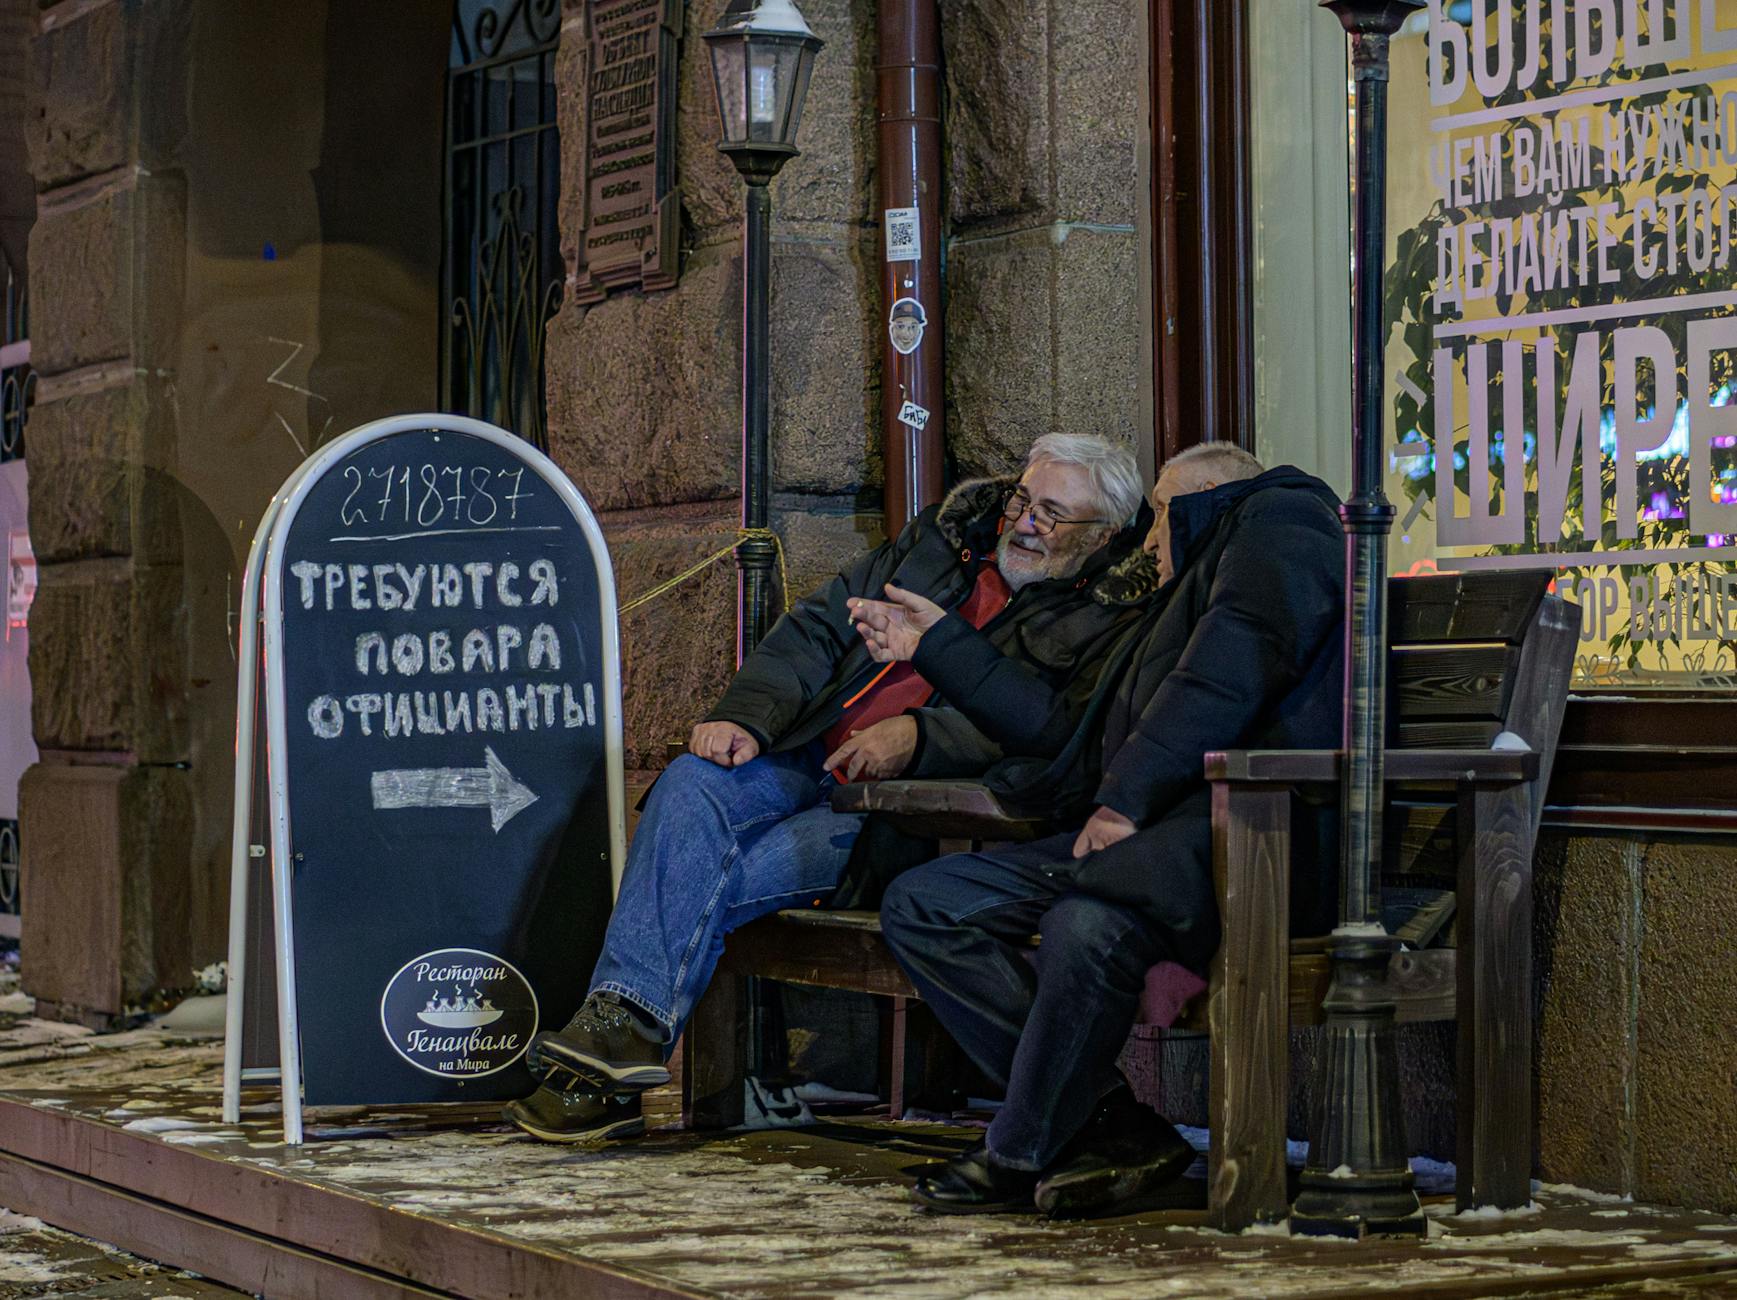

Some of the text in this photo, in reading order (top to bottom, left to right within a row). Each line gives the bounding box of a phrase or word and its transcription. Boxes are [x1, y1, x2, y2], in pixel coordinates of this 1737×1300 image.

[1430, 91, 1737, 209] ЧЕМ ВАМ НУЖНО
[1433, 191, 1621, 315] ДЕЛАЙТЕ
[1434, 317, 1737, 547] ШИРЕ
[341, 464, 534, 526] 2718787
[291, 559, 558, 611] ТРЕБУЮТСЯ
[1557, 574, 1737, 642] ОР ВЫШЕ
[355, 622, 560, 676] ПОВАРА
[307, 682, 596, 740] ОФИЦИАНТЫ
[414, 962, 507, 987] Ресторан
[407, 1027, 519, 1057] Генацвале
[439, 1059, 490, 1072] на Мира
